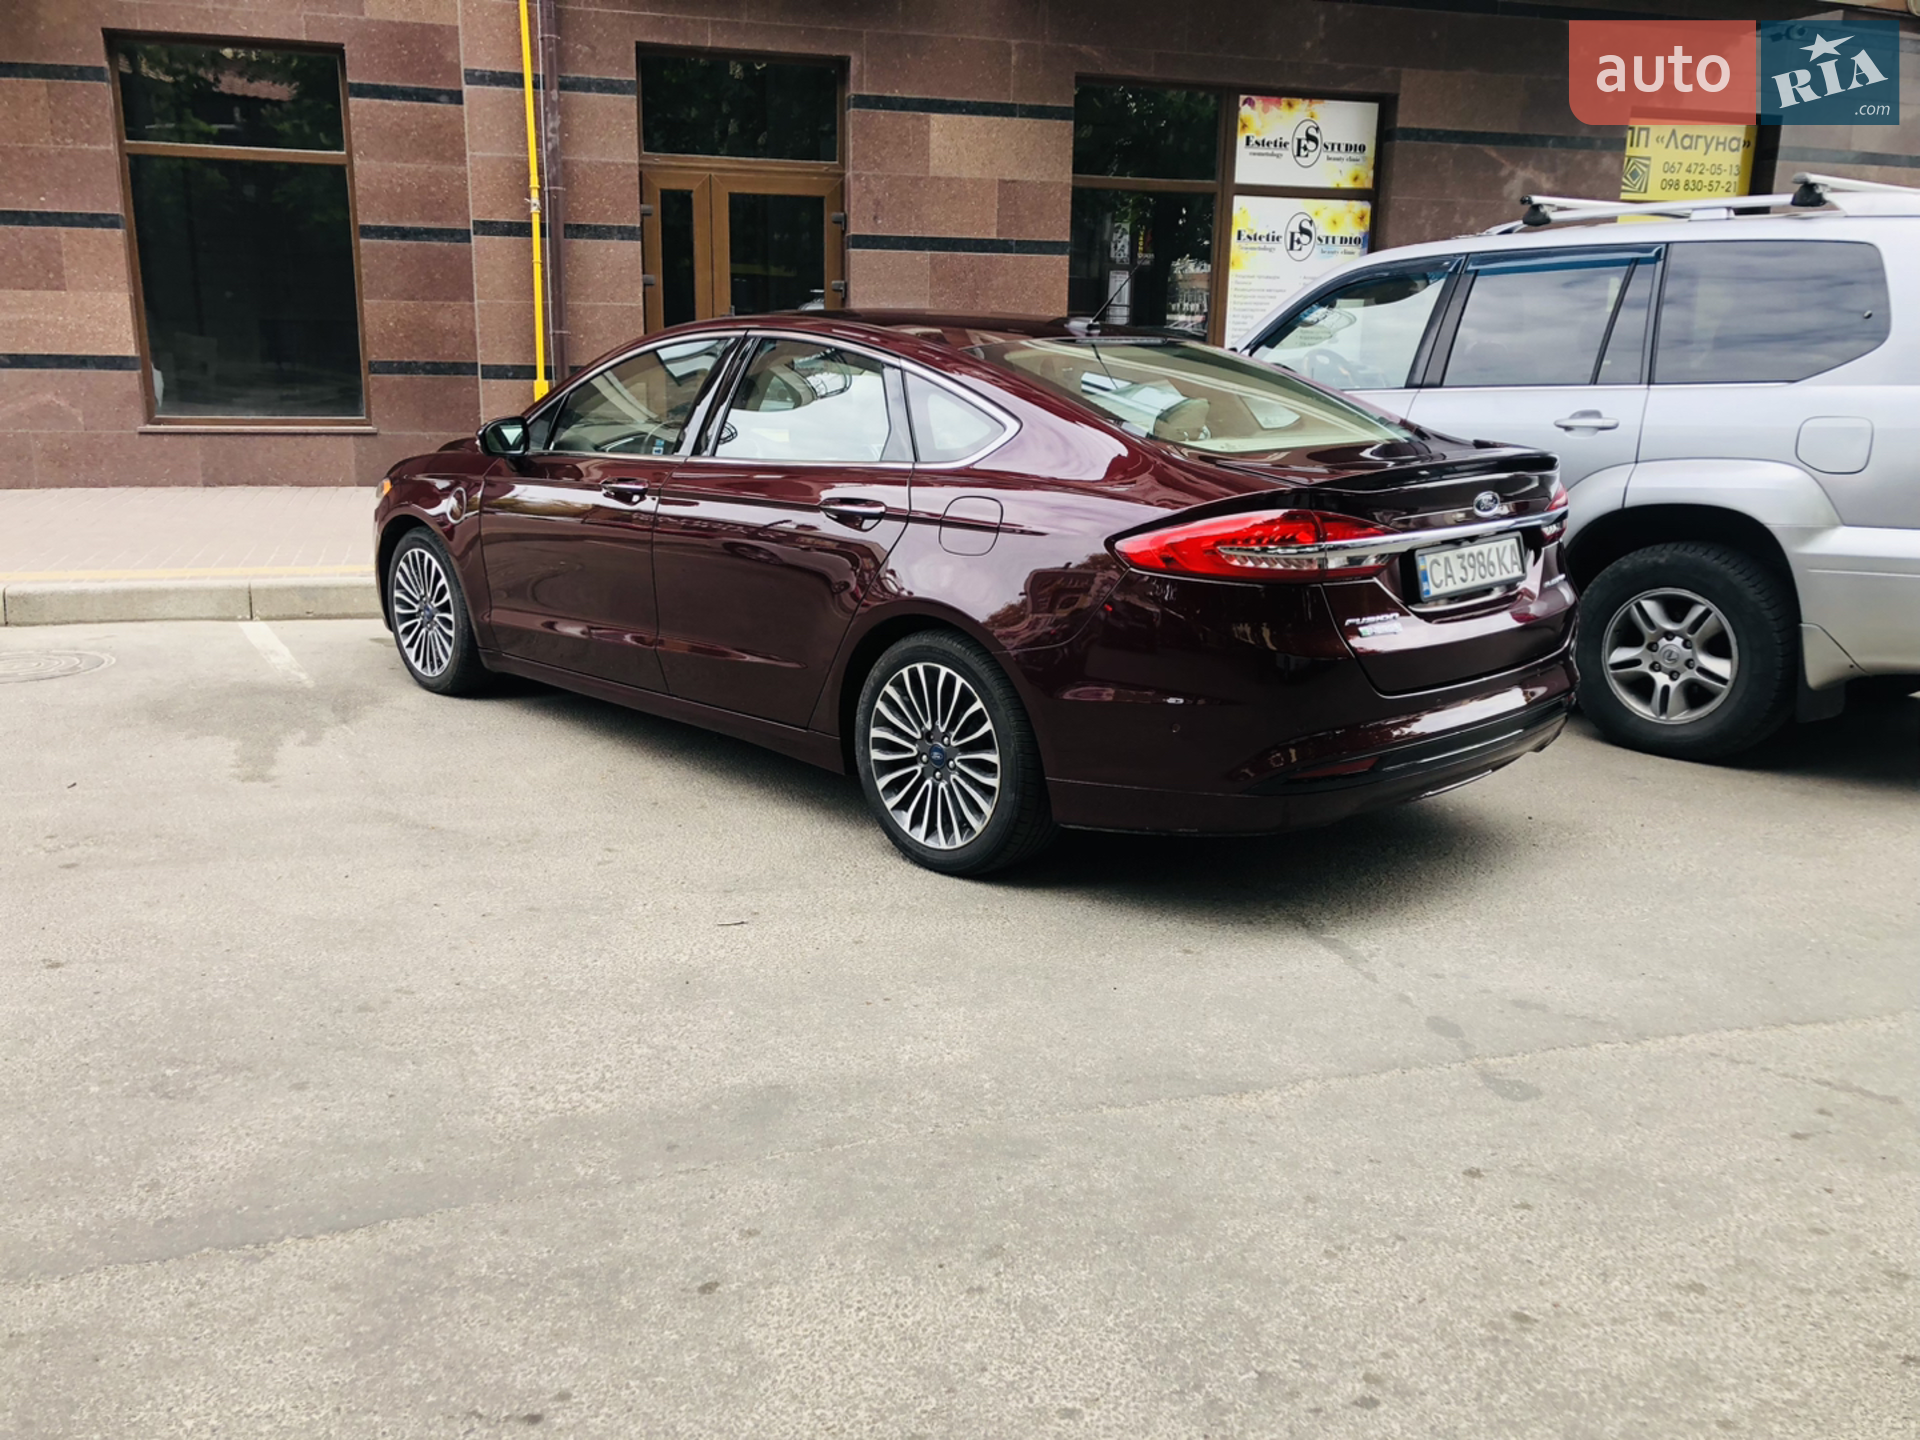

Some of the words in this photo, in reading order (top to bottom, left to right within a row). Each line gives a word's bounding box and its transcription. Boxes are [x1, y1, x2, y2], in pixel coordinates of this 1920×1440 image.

[1245, 135, 1290, 148] Estetic
[1323, 142, 1366, 153] STUDIO
[1656, 128, 1751, 156] «Лагуна»
[1662, 161, 1683, 174] 067
[1685, 162, 1740, 176] 472-05-13
[1660, 178, 1681, 191] 098
[1683, 180, 1738, 193] 830-57-21
[1237, 229, 1283, 242] Estetic
[1317, 235, 1362, 245] STUDIO
